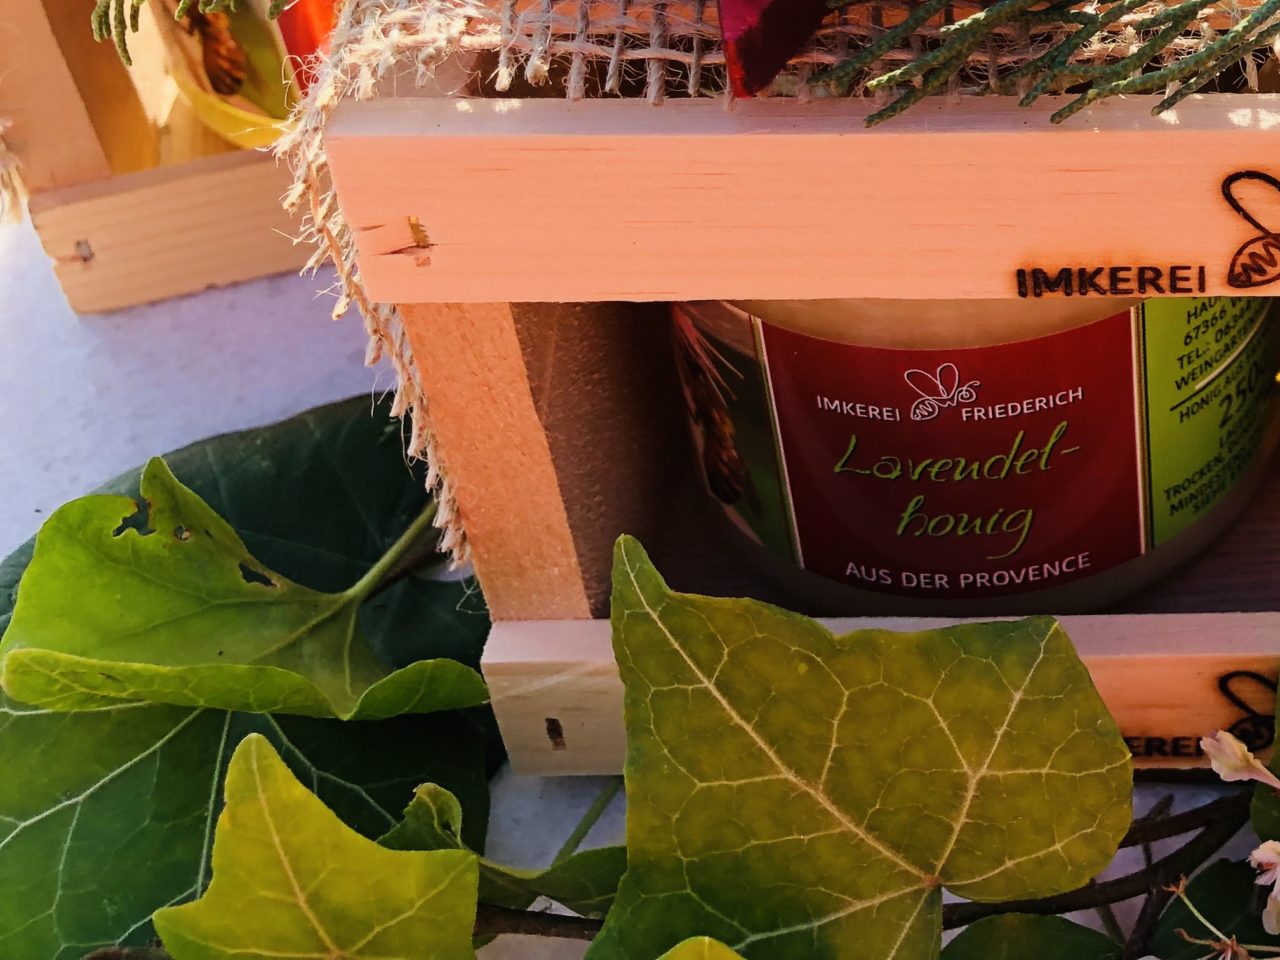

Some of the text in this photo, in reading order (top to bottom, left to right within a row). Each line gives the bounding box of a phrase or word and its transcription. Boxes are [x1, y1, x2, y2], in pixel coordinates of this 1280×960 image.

[1016, 265, 1206, 297] IMKEREI
[817, 387, 1083, 422] IMKEREI FRIEDERICH
[834, 420, 1080, 482] Lavendel-
[896, 495, 1033, 559] honig
[845, 551, 1091, 589] AUS DER PROVENCE
[1123, 736, 1204, 757] EREI
